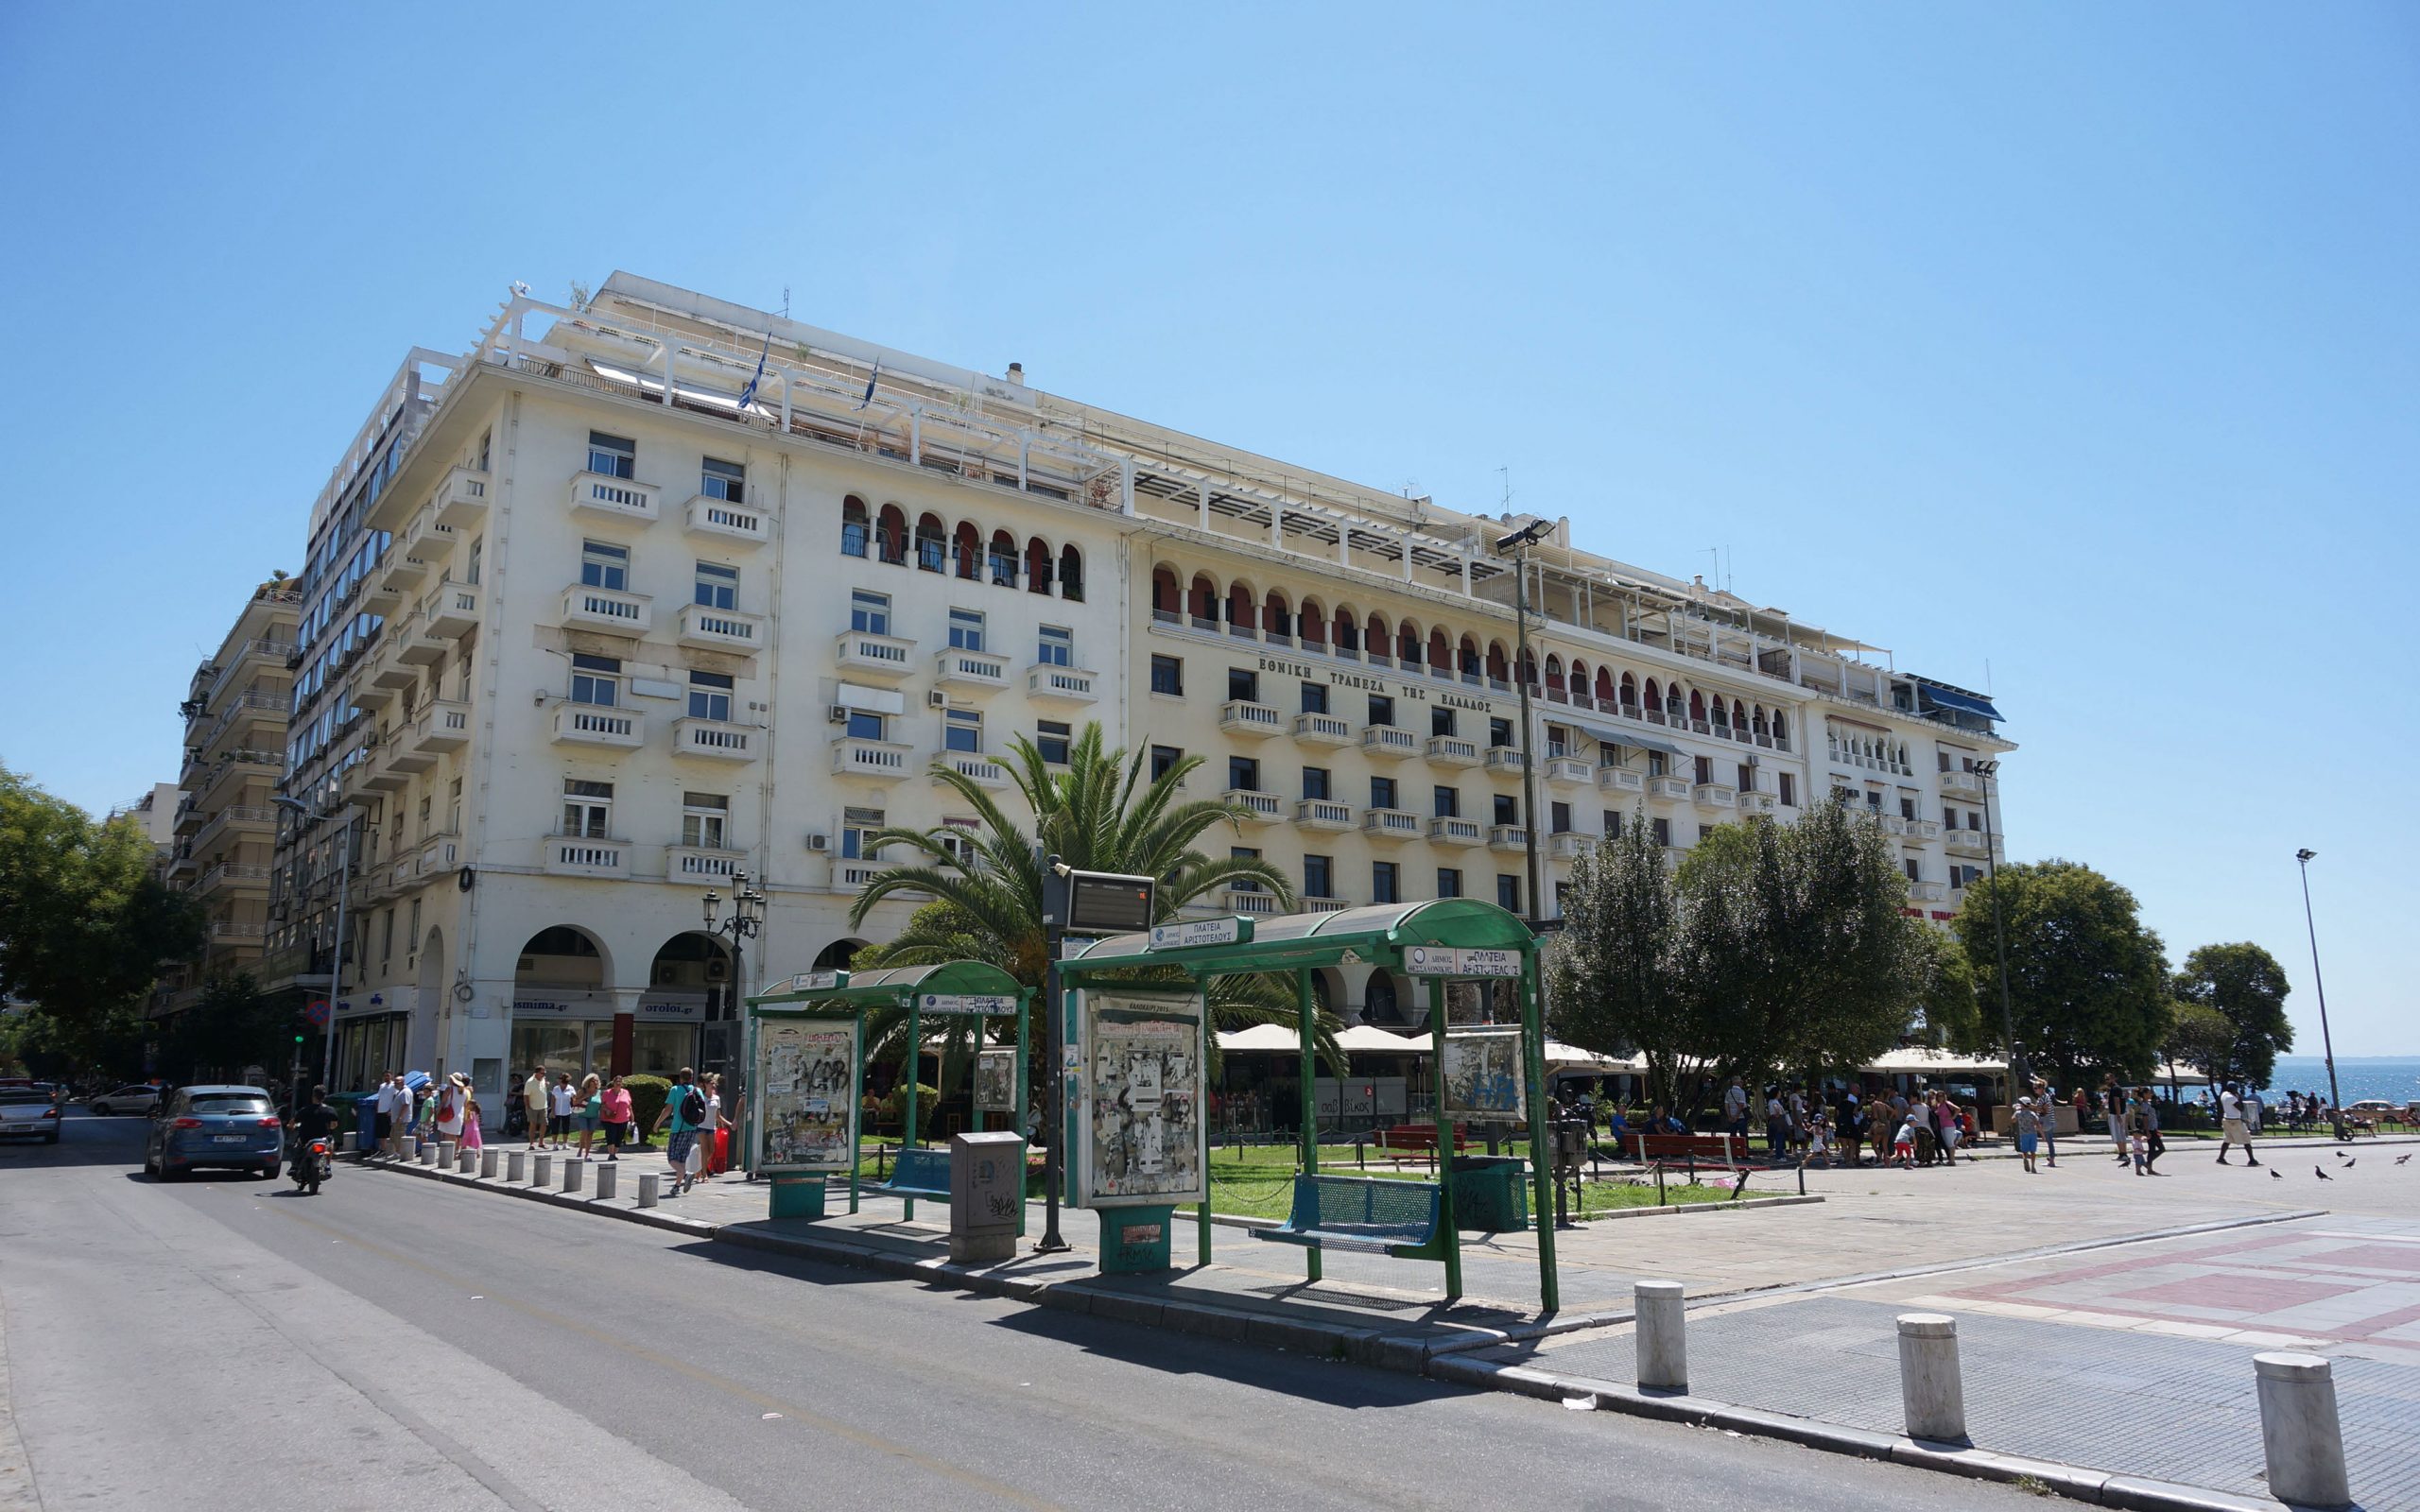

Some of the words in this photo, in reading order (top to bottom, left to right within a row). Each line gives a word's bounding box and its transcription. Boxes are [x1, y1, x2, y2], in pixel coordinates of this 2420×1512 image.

[1259, 658, 1312, 679] ΕΘΝΙΚΗ
[1330, 672, 1385, 693] ΤΡΑΠΕΖΑ
[1402, 686, 1426, 700] ΤΗΣ
[1441, 694, 1492, 713] ΕΛΛΑΔΟΣ
[1194, 922, 1221, 933] ΠΛΑΤΕΙΑ
[1184, 932, 1232, 944] ΑΡΙΣΤΟΤΕΛΟΥΣ
[1474, 951, 1507, 962] ΠΛΑΤΕΙΑ
[1462, 964, 1519, 975] ΑΡΙΣΤΟΤΕΛΟΣ
[645, 1003, 694, 1015] oroloi.gr
